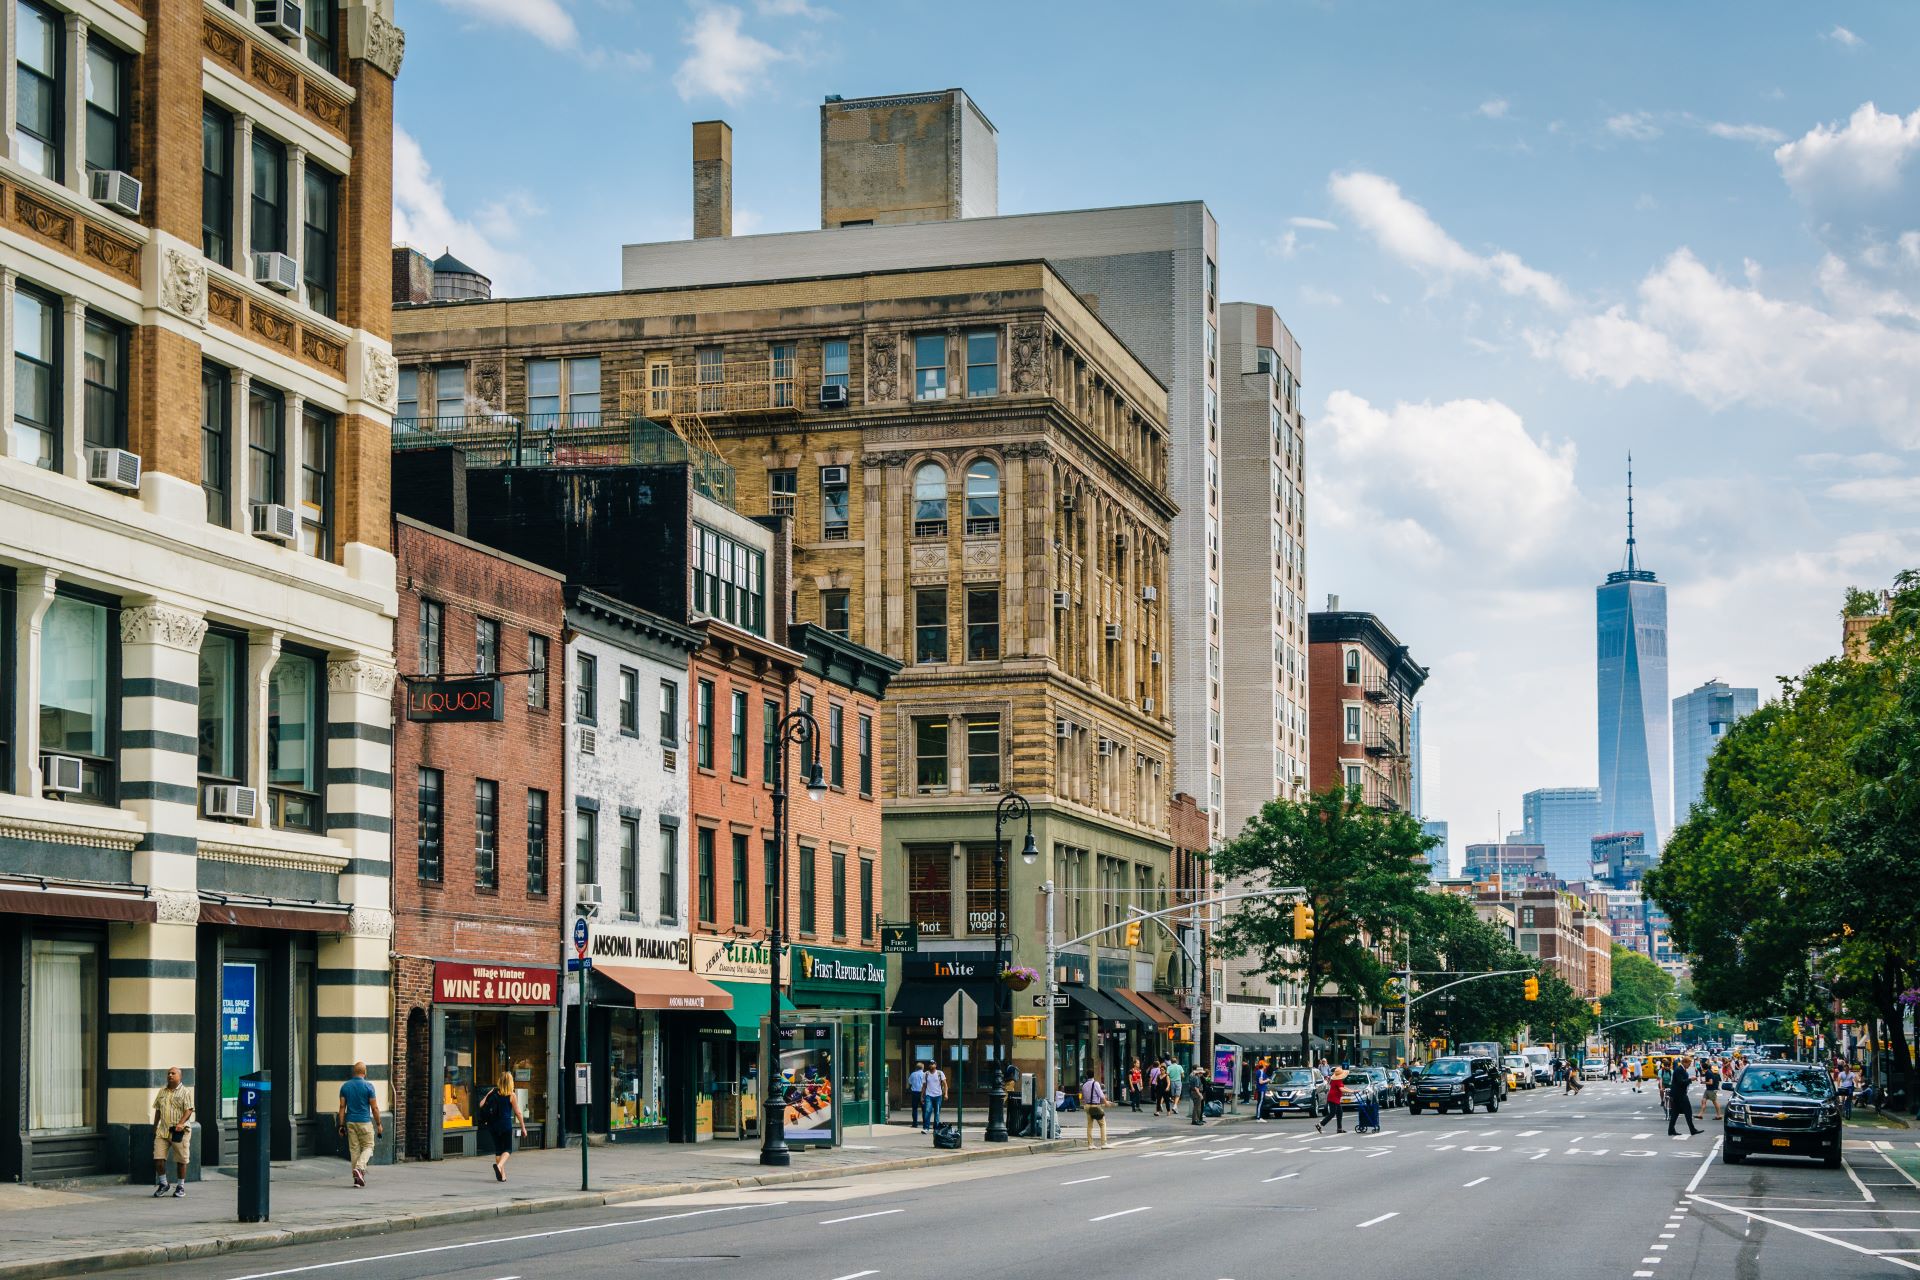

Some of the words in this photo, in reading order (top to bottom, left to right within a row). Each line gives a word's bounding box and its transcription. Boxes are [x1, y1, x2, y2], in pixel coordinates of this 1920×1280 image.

[411, 691, 491, 712] LIQUOR
[922, 921, 941, 932] hot
[970, 921, 992, 931] yoga
[592, 934, 632, 957] ANSONIA
[635, 938, 679, 961] PHARMACY
[727, 946, 772, 966] CLEANE
[473, 967, 499, 980] Village
[500, 969, 526, 980] Vintner
[814, 958, 834, 979] FIRST
[834, 960, 867, 981] REPUBLIC
[867, 963, 885, 982] BANK
[443, 979, 481, 999] WINE
[484, 982, 495, 999] &
[498, 981, 551, 1003] LIQUOR
[247, 1091, 256, 1105] P
